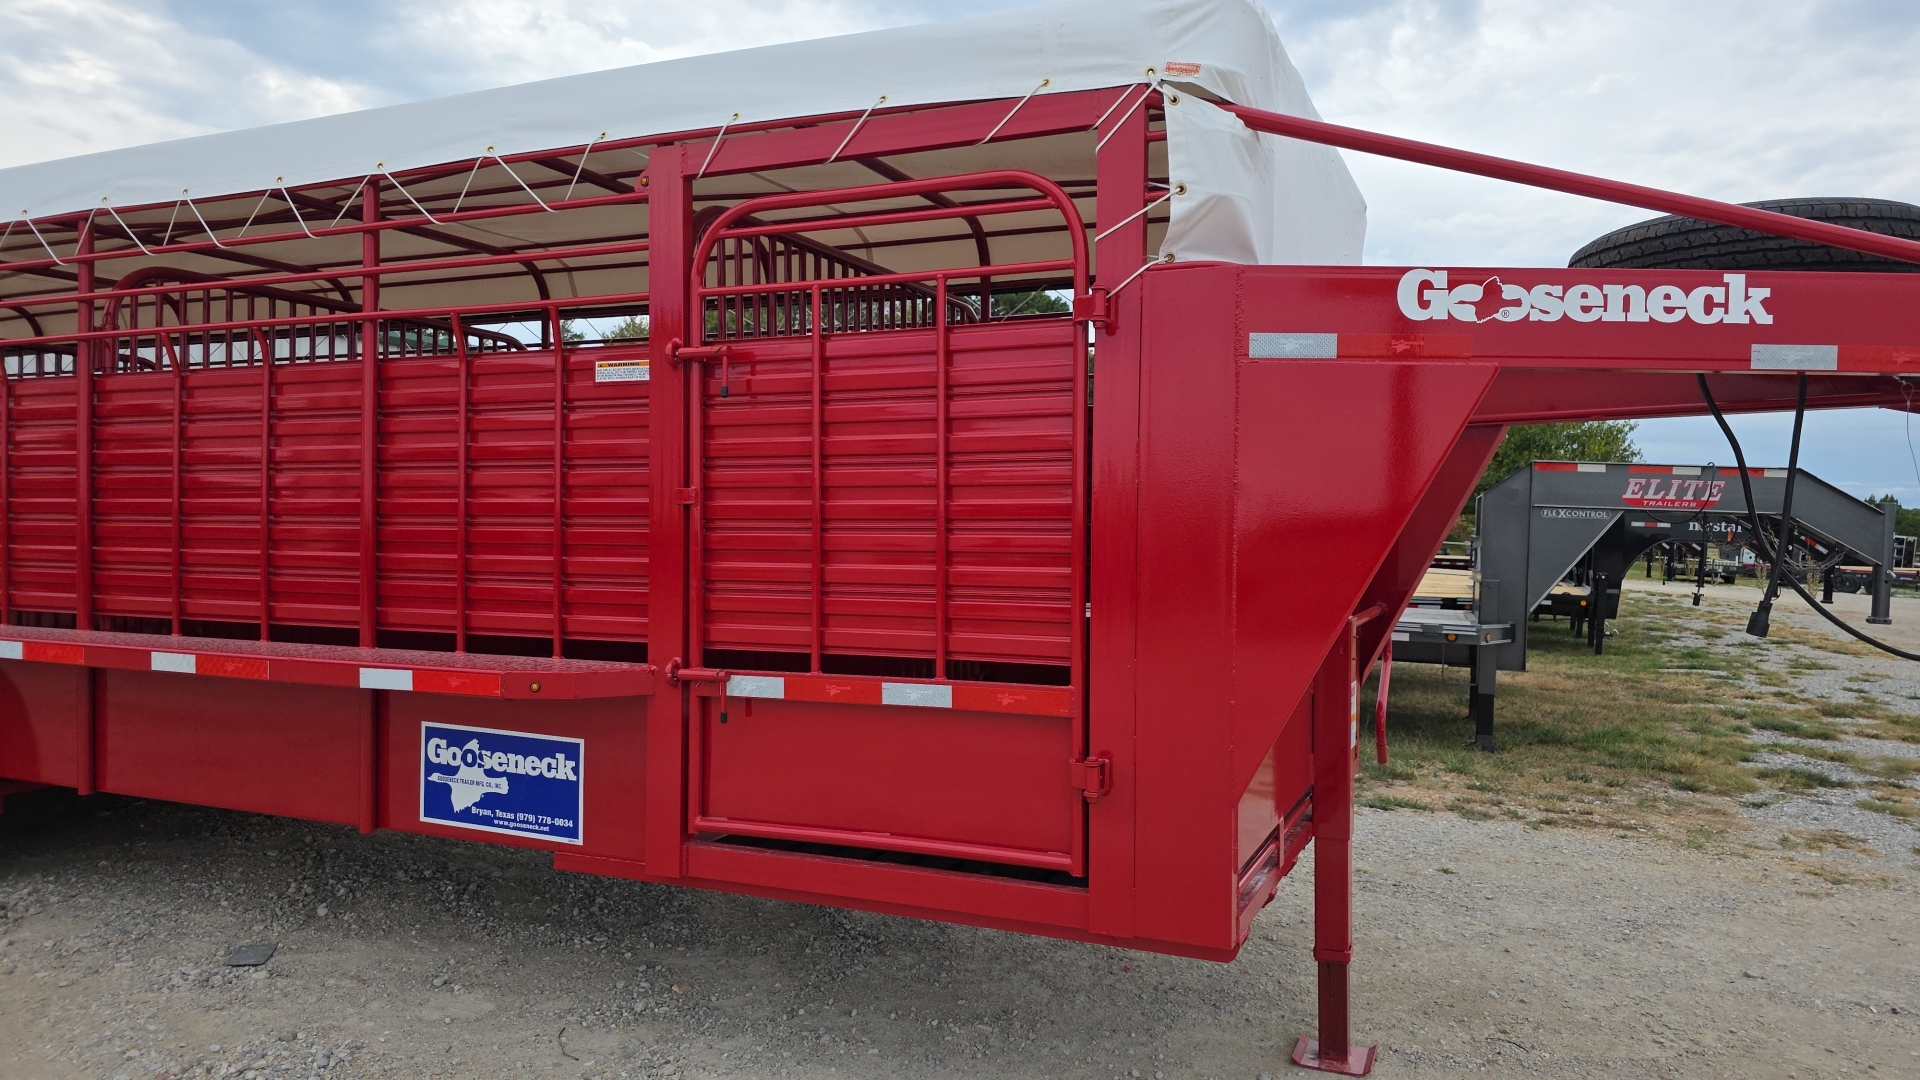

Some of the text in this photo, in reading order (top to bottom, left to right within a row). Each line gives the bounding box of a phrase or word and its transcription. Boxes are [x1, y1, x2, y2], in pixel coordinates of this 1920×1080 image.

[1397, 269, 1773, 325] Gooseneck
[1622, 478, 1726, 501] ELITE
[1642, 500, 1697, 508] TRAILERS
[1543, 508, 1608, 518] FLEXCONTROL
[427, 737, 577, 781] Gooseneck
[437, 775, 459, 784] GOOSENECK
[460, 778, 475, 786] TRAILER
[471, 806, 574, 828] Bryan, Texas (979) 778-0034
[493, 819, 550, 832] www.gooseneck.net
